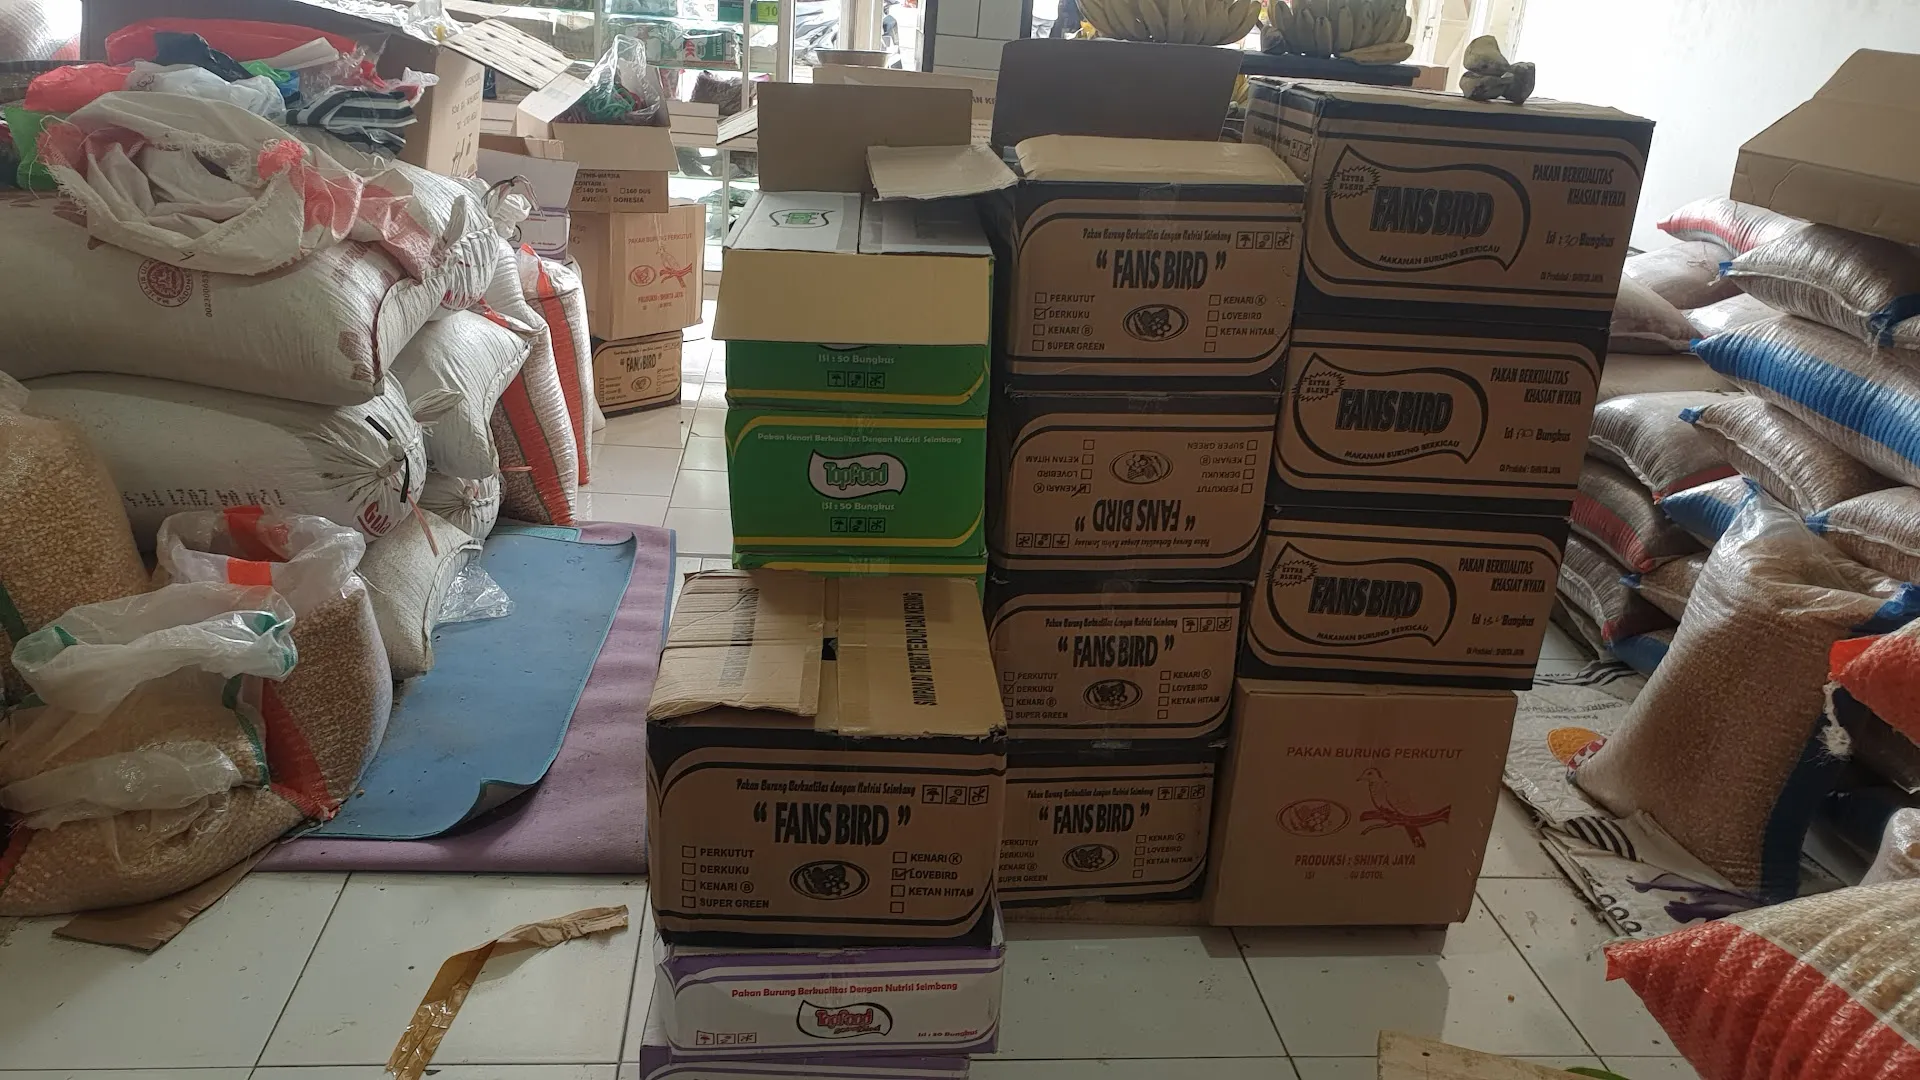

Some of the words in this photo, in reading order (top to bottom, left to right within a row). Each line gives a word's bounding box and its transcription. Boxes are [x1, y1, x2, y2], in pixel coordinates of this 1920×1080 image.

[1532, 164, 1561, 181] PAKAN
[1562, 166, 1614, 185] BERKUALITAS
[1567, 188, 1600, 206] KHASIAT
[1600, 190, 1626, 207] NYATA
[1379, 255, 1421, 265] MAKANAN
[1424, 251, 1458, 264] BURUNG
[1460, 245, 1500, 256] BERKICAU
[1112, 250, 1161, 289] FANS
[1162, 251, 1209, 290] BIRD
[1050, 294, 1096, 303] PERKUTUT
[1223, 296, 1254, 304] KENARI
[1048, 310, 1090, 319] DERKUKU
[1222, 312, 1262, 320] LOVEBIRD
[1048, 326, 1080, 335] KENARI
[1220, 328, 1248, 336] KETAN
[1249, 328, 1275, 336] HITAM
[1047, 342, 1075, 351] SUPER
[1076, 342, 1106, 351] GREEN
[643, 354, 656, 370] BIRD
[852, 354, 895, 364] Bungkus
[1490, 367, 1518, 382] PAKAN
[1518, 368, 1570, 385] BERKUALITAS
[1524, 389, 1558, 404] KHASIAT
[1557, 390, 1582, 405] NYATA
[757, 433, 785, 441] Pakan
[786, 433, 813, 442] Kenari
[815, 434, 860, 443] Berkualitas
[862, 435, 893, 445] Dengan
[894, 435, 921, 443] Nutrisi
[923, 435, 962, 445] Seimbang
[1187, 442, 1216, 450] GREEN
[1217, 441, 1245, 449] SUPER
[1025, 456, 1050, 464] HITAM
[1052, 456, 1079, 464] KETAN
[1211, 456, 1242, 464] KENARI
[1344, 450, 1384, 460] MAKANAN
[1037, 470, 1078, 478] LOVEBIRD
[1201, 471, 1241, 479] DERKUKU
[1046, 485, 1077, 493] KENARI
[1196, 484, 1239, 493] PERKUTUT
[854, 502, 895, 512] Bungkus
[1092, 499, 1134, 532] BIRD
[1136, 500, 1182, 532] FANS
[1459, 558, 1484, 572] PAKAN
[1485, 559, 1534, 574] BERKUALITAS
[1490, 578, 1521, 592] KHASIAT
[1522, 579, 1546, 592] NYATA
[1317, 632, 1356, 641] MAKANAN
[1073, 635, 1116, 668] FANS
[1117, 635, 1158, 667] BIRD
[1017, 672, 1058, 680] PERKUTUT
[1173, 671, 1200, 679] KENARI
[1016, 685, 1054, 693] DERKUKU
[1172, 684, 1208, 692] LOVEBIRD
[1016, 698, 1044, 706] KENARI
[1171, 697, 1196, 705] KETAN
[1197, 696, 1220, 704] HITAM
[1015, 711, 1041, 719] SUPER
[1043, 711, 1068, 719] GREEN
[1286, 746, 1331, 758] PAKAN
[1335, 747, 1391, 760] BURUNG
[1394, 748, 1464, 760] PERKUTUT
[736, 778, 758, 790] Pakan
[761, 779, 787, 794] Burung
[788, 780, 828, 792] Berkualitas
[830, 781, 855, 795] dengan
[857, 782, 881, 794] Nutrisi
[883, 783, 916, 797] Seimbang
[1053, 804, 1098, 834] FANS
[1098, 803, 1134, 833] BIRD
[775, 802, 832, 845] FANS
[835, 803, 889, 846] BIRD
[700, 848, 755, 858] PERKUTUT
[1147, 846, 1181, 854] LOVEBIRD
[911, 853, 947, 863] KENARI
[1146, 857, 1170, 865] KETAN
[1294, 854, 1346, 866] PRODUKSI
[1353, 854, 1389, 866] SHINTA
[1391, 854, 1416, 866] JAYA
[700, 865, 749, 874] DERKUKU
[909, 870, 958, 880] LOVEBIRD
[700, 881, 737, 891] KENARI
[909, 886, 941, 896] KETAN
[944, 887, 974, 897] HITAM
[700, 898, 732, 907] SUPER
[735, 899, 769, 908] GREEN
[732, 990, 761, 998] Pakan
[763, 988, 796, 997] Burung
[798, 986, 848, 996] Berkualitas
[850, 984, 883, 994] Dengan
[885, 983, 914, 992] Nutrisi
[916, 982, 958, 992] Seimbang
